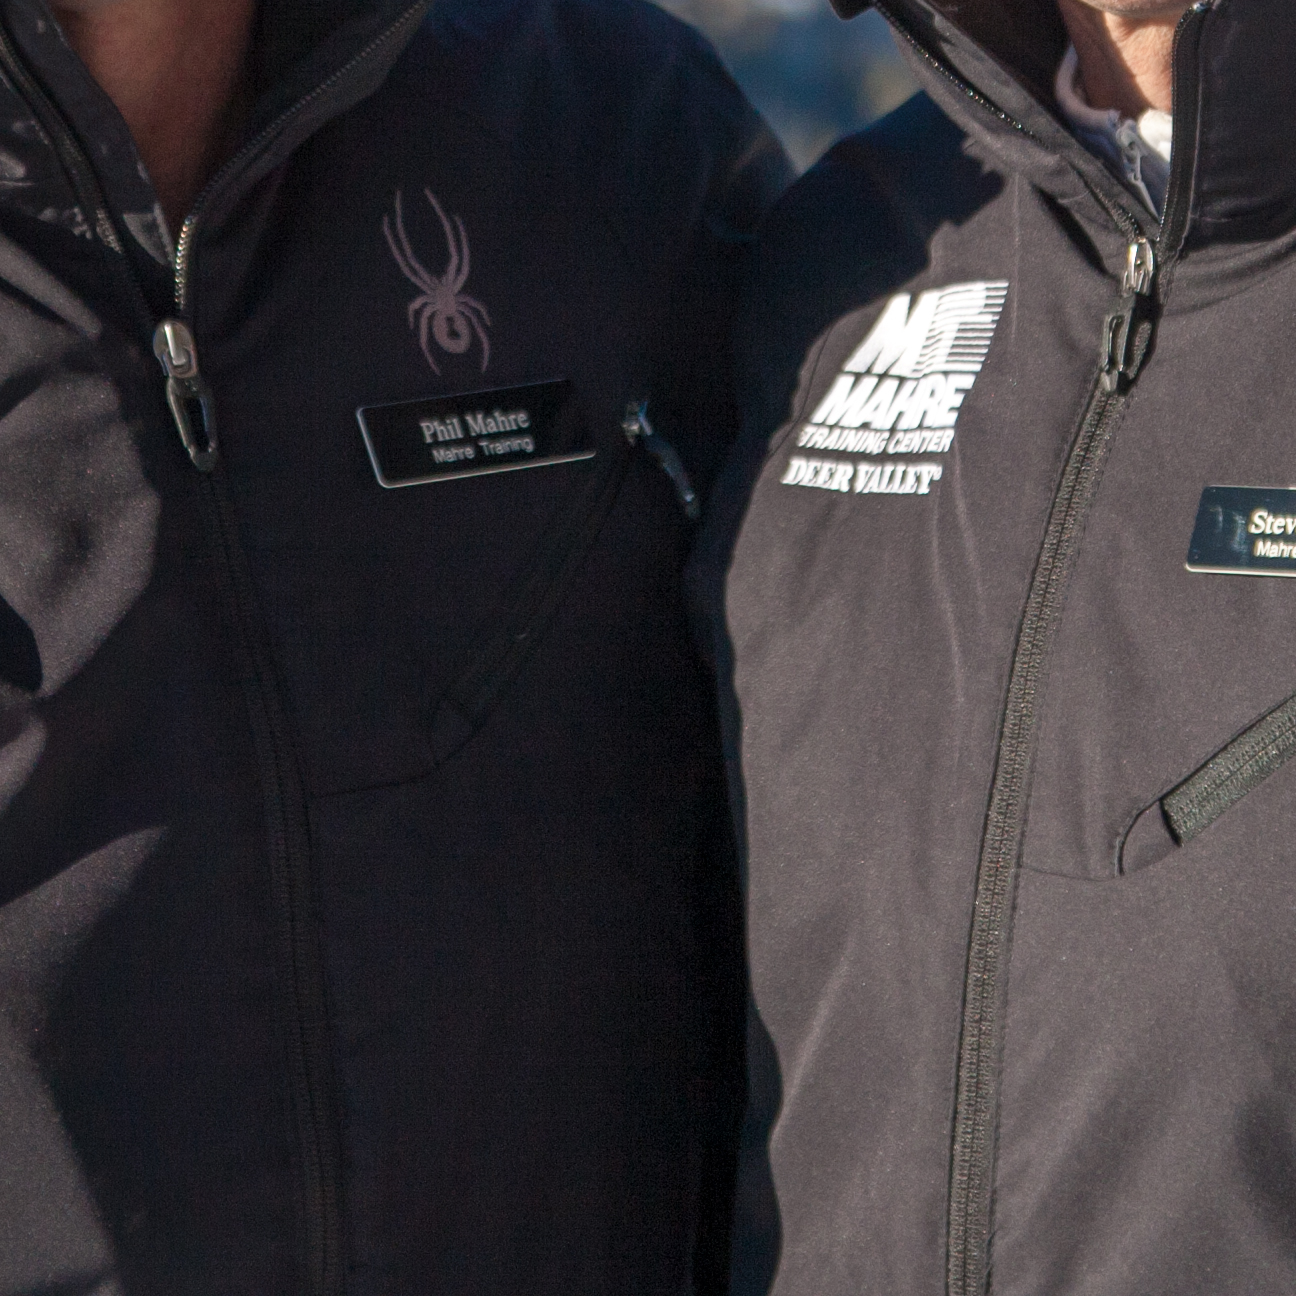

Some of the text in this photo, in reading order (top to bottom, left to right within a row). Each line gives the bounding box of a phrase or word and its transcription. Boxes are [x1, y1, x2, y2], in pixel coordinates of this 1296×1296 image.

[810, 373, 976, 430] MAHRE
[419, 409, 531, 444] Phil Mahre
[797, 424, 955, 455] TRAINING CENTER
[431, 435, 535, 464] Mahre Training
[781, 456, 854, 493] DEER
